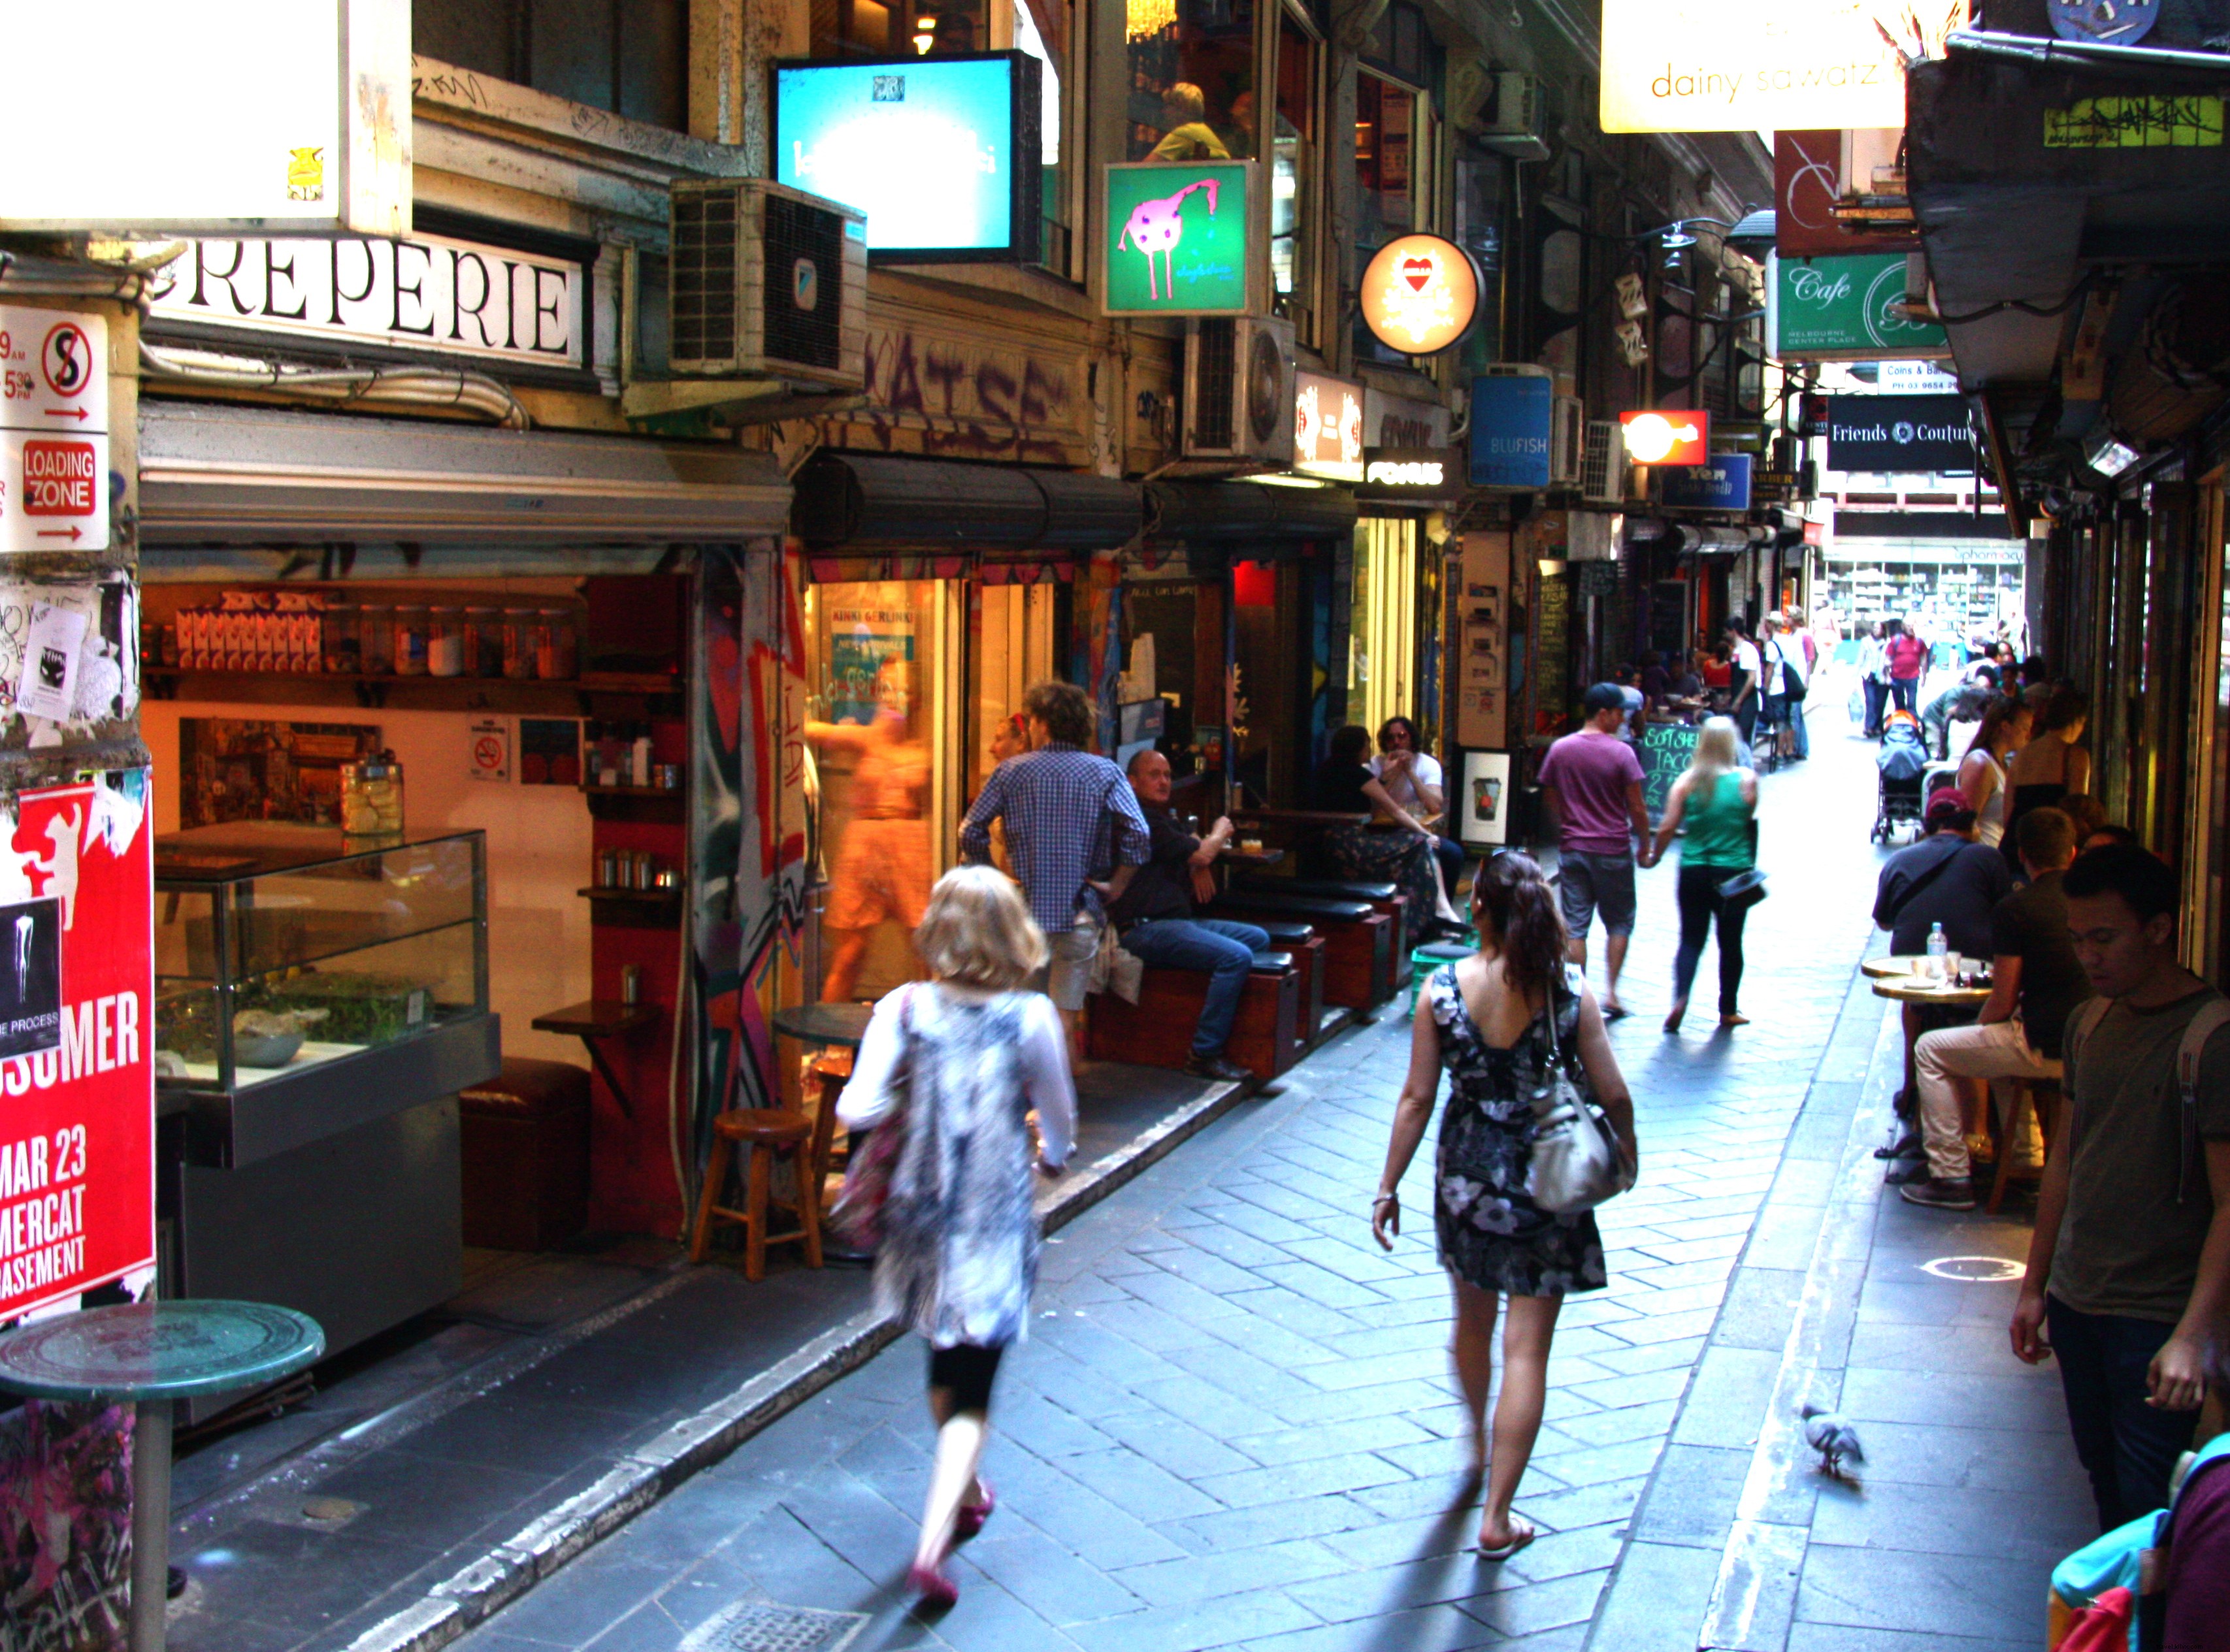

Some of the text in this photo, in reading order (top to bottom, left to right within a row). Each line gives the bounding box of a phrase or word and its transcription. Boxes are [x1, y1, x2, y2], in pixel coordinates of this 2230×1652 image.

[1651, 50, 1888, 104] dainy sawatz
[150, 239, 568, 355] REPERIE
[1788, 267, 1852, 310] Cafe
[1888, 366, 1912, 376] Coins
[1916, 366, 1922, 375] &
[1491, 437, 1548, 454] BLUFISH
[1833, 423, 1888, 442] Friends
[1917, 423, 1967, 444] Coutur
[24, 450, 94, 478] LOADING
[29, 479, 90, 508] ZONE
[11, 1011, 59, 1037] PROCESS
[55, 1123, 87, 1183] 23
[0, 1235, 86, 1302] ASEMENT
